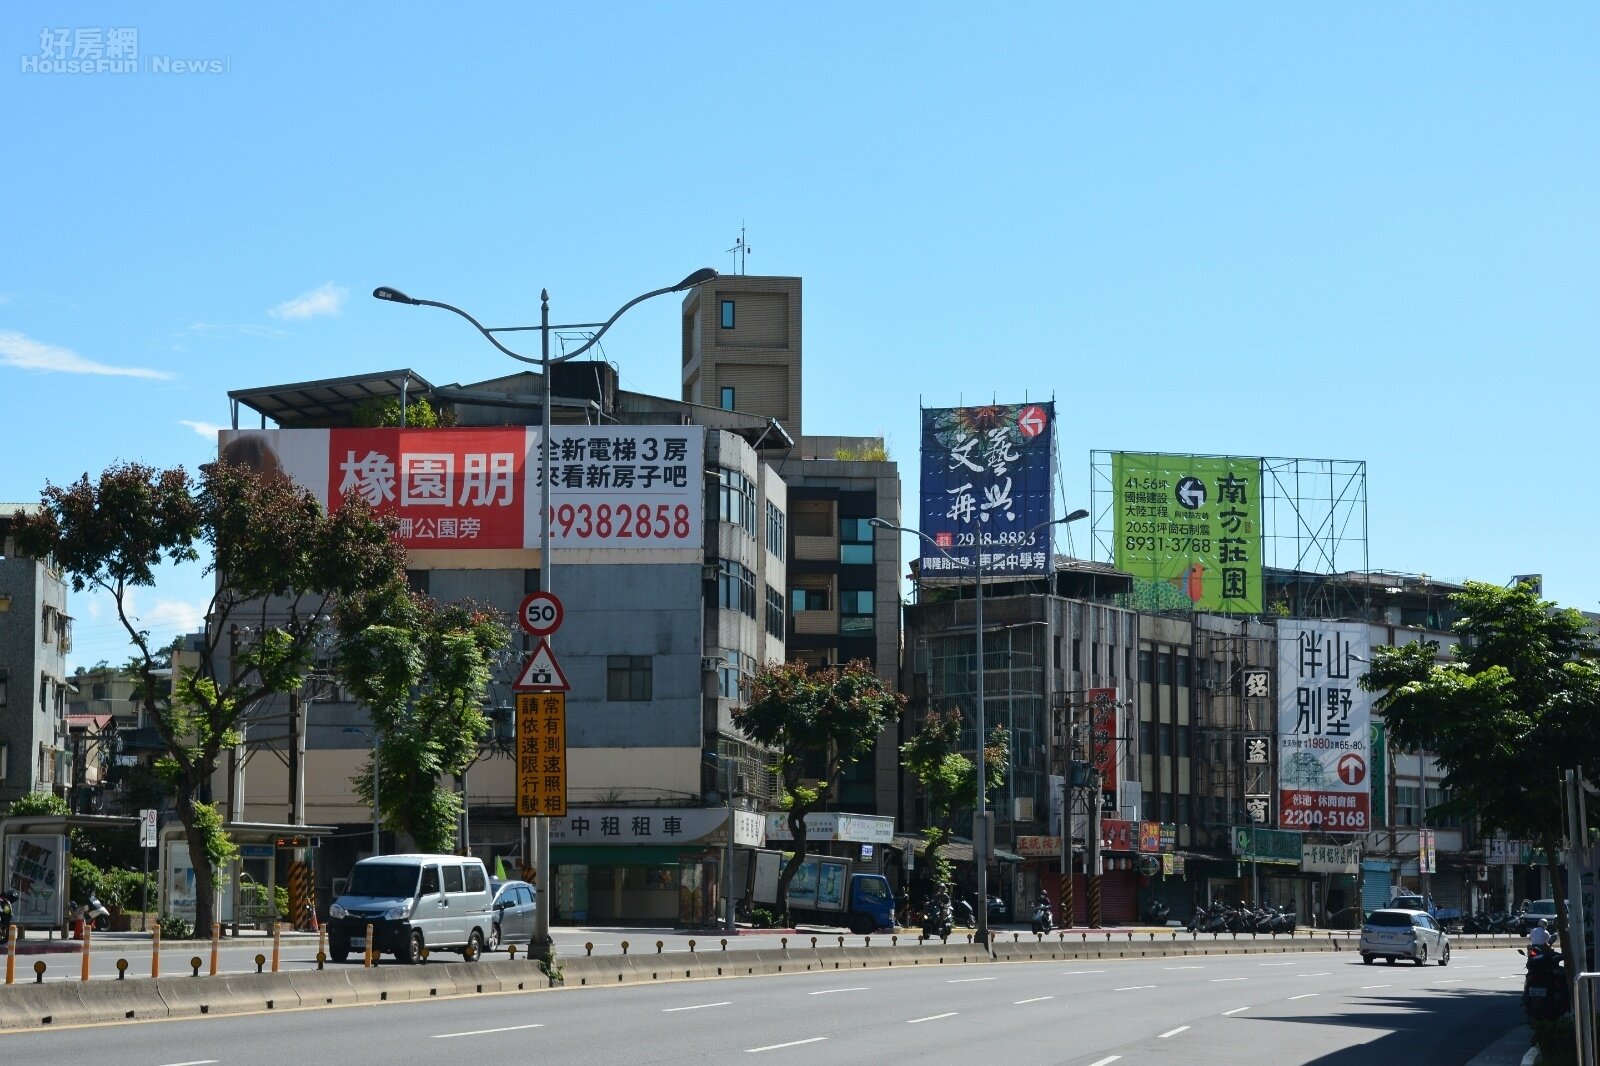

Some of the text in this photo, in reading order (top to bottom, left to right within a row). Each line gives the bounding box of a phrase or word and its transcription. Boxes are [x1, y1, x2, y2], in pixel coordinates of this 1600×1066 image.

[536, 437, 688, 462] 全新電梯3房
[338, 450, 515, 507] 橡園朋
[536, 464, 688, 488] 來看新房子吧
[1124, 477, 1168, 490] 41-56坪
[1124, 491, 1168, 504] 國揚建設
[1125, 505, 1169, 518] 大陸工程
[1125, 536, 1211, 553] 8931-3788
[528, 605, 555, 622] 50
[1299, 630, 1350, 679] 伴山
[1294, 687, 1353, 736] 別墅
[521, 698, 539, 813] 請依速限行駛
[543, 697, 561, 812] 常有測速照相
[571, 815, 683, 837] 中租租車
[1284, 809, 1365, 826] 2200-5168
